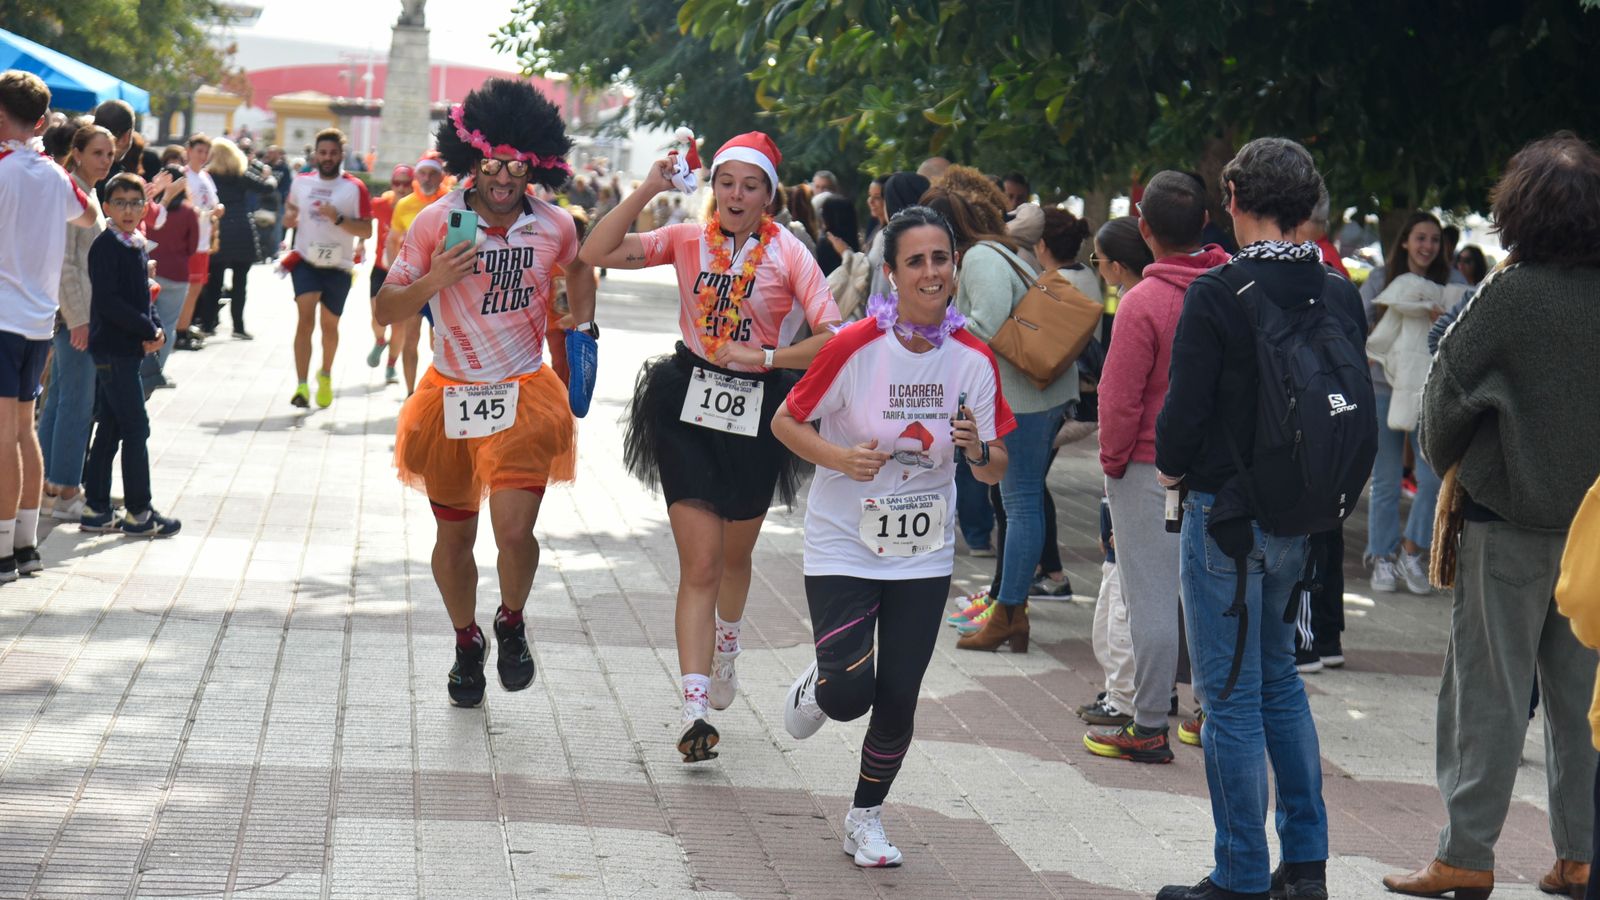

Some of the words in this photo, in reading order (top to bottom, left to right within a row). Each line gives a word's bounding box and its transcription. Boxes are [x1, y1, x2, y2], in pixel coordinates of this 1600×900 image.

[318, 248, 332, 259] 72
[473, 247, 534, 274] CORRO
[490, 269, 523, 291] POR
[481, 286, 534, 315] ELLOS
[481, 383, 514, 391] SILVESTRE
[898, 383, 944, 398] CARRERA
[459, 398, 505, 421] 145
[700, 387, 746, 417] 108
[889, 397, 904, 408] SAN
[906, 397, 943, 408] SILVESTRE
[914, 412, 938, 420] DICIEMBRE
[938, 412, 949, 420] 2023
[903, 494, 941, 503] SILVESTRE
[889, 502, 918, 511] TARIFEÑA
[877, 512, 930, 538] 110
